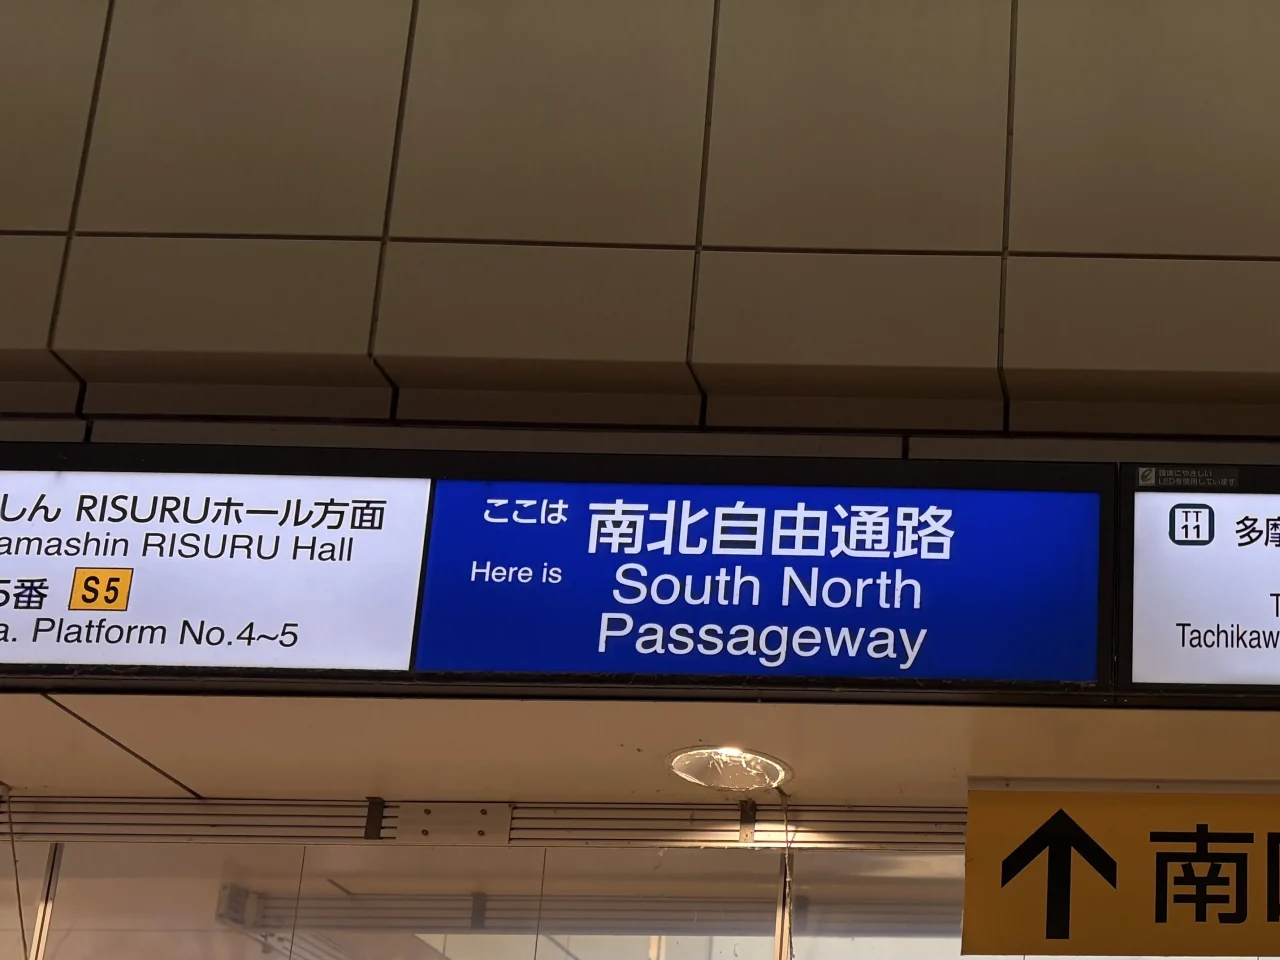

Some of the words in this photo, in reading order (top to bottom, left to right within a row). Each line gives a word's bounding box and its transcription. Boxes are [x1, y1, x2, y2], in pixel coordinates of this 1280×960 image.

[76, 495, 387, 532] RISURUホール方面
[483, 499, 568, 524] ここは
[1181, 511, 1202, 522] TT
[587, 498, 955, 560] 南北自由通路
[1181, 525, 1201, 539] 11
[142, 532, 281, 562] RISURU
[292, 536, 354, 562] Hall
[470, 561, 532, 583] Here
[541, 563, 562, 584] is
[612, 563, 762, 606] South
[781, 567, 922, 609] North
[81, 575, 120, 604] S5
[32, 617, 168, 646] Platform
[597, 613, 928, 669] Passageway
